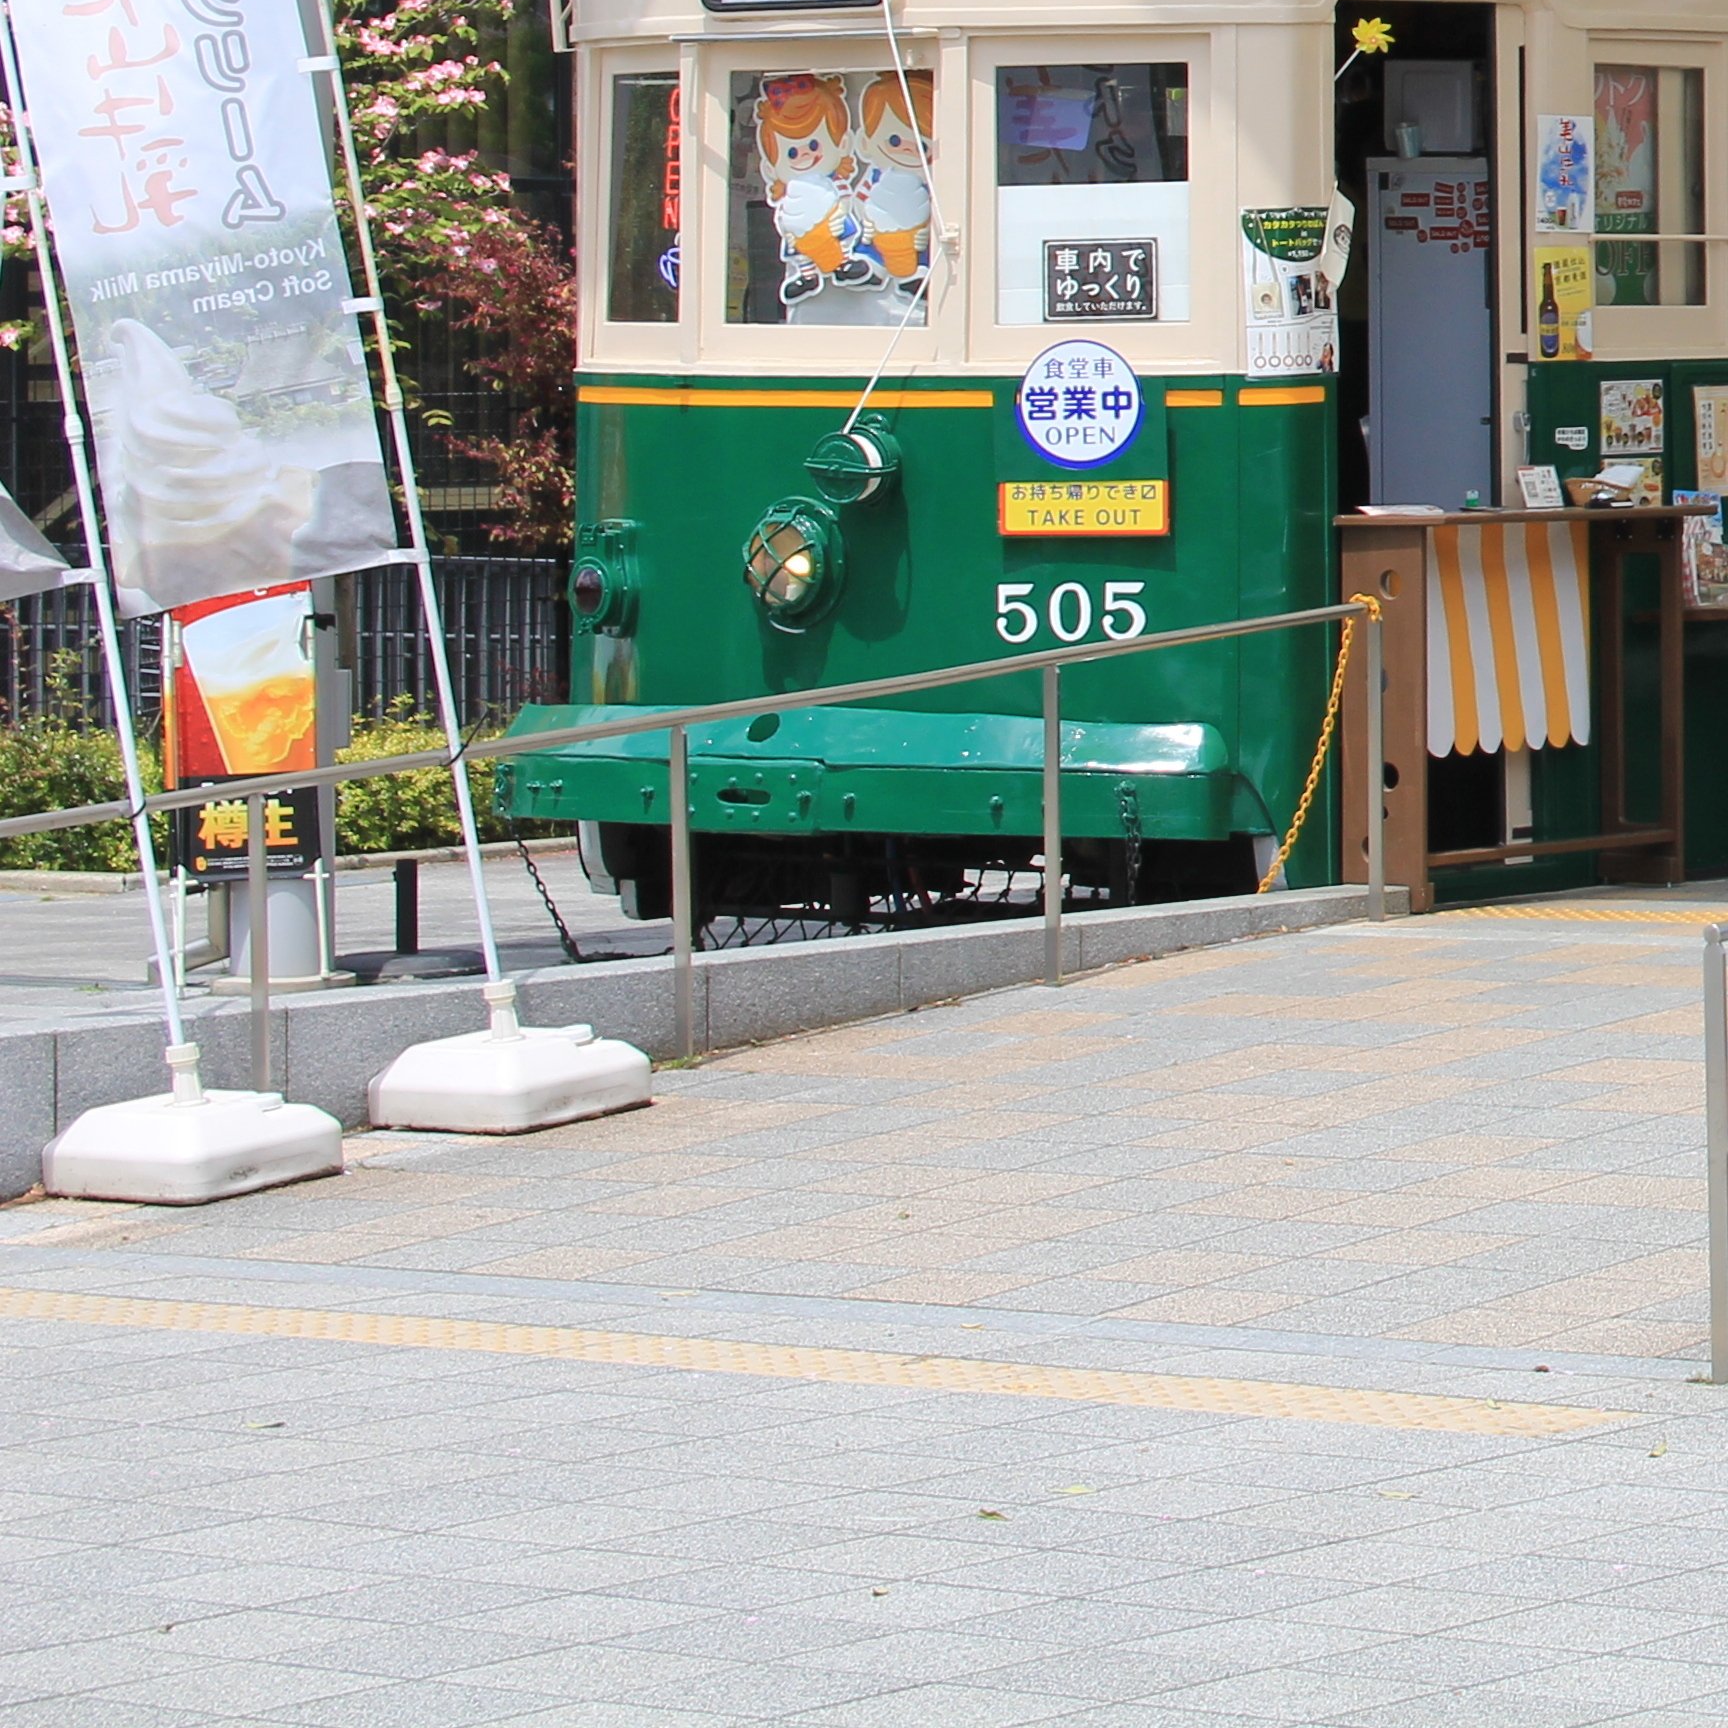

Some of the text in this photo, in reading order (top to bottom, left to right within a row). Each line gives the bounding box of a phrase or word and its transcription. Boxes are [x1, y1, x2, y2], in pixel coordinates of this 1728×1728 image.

[1055, 247, 1146, 274] 車内で
[1055, 274, 1143, 301] ゆっくり
[1043, 356, 1114, 380] 食堂車
[1025, 385, 1133, 421] 営業中
[1045, 426, 1116, 446] OPEN
[1027, 508, 1142, 527] TAKE OUT
[996, 581, 1148, 644] 505
[198, 798, 299, 850] 樽生
